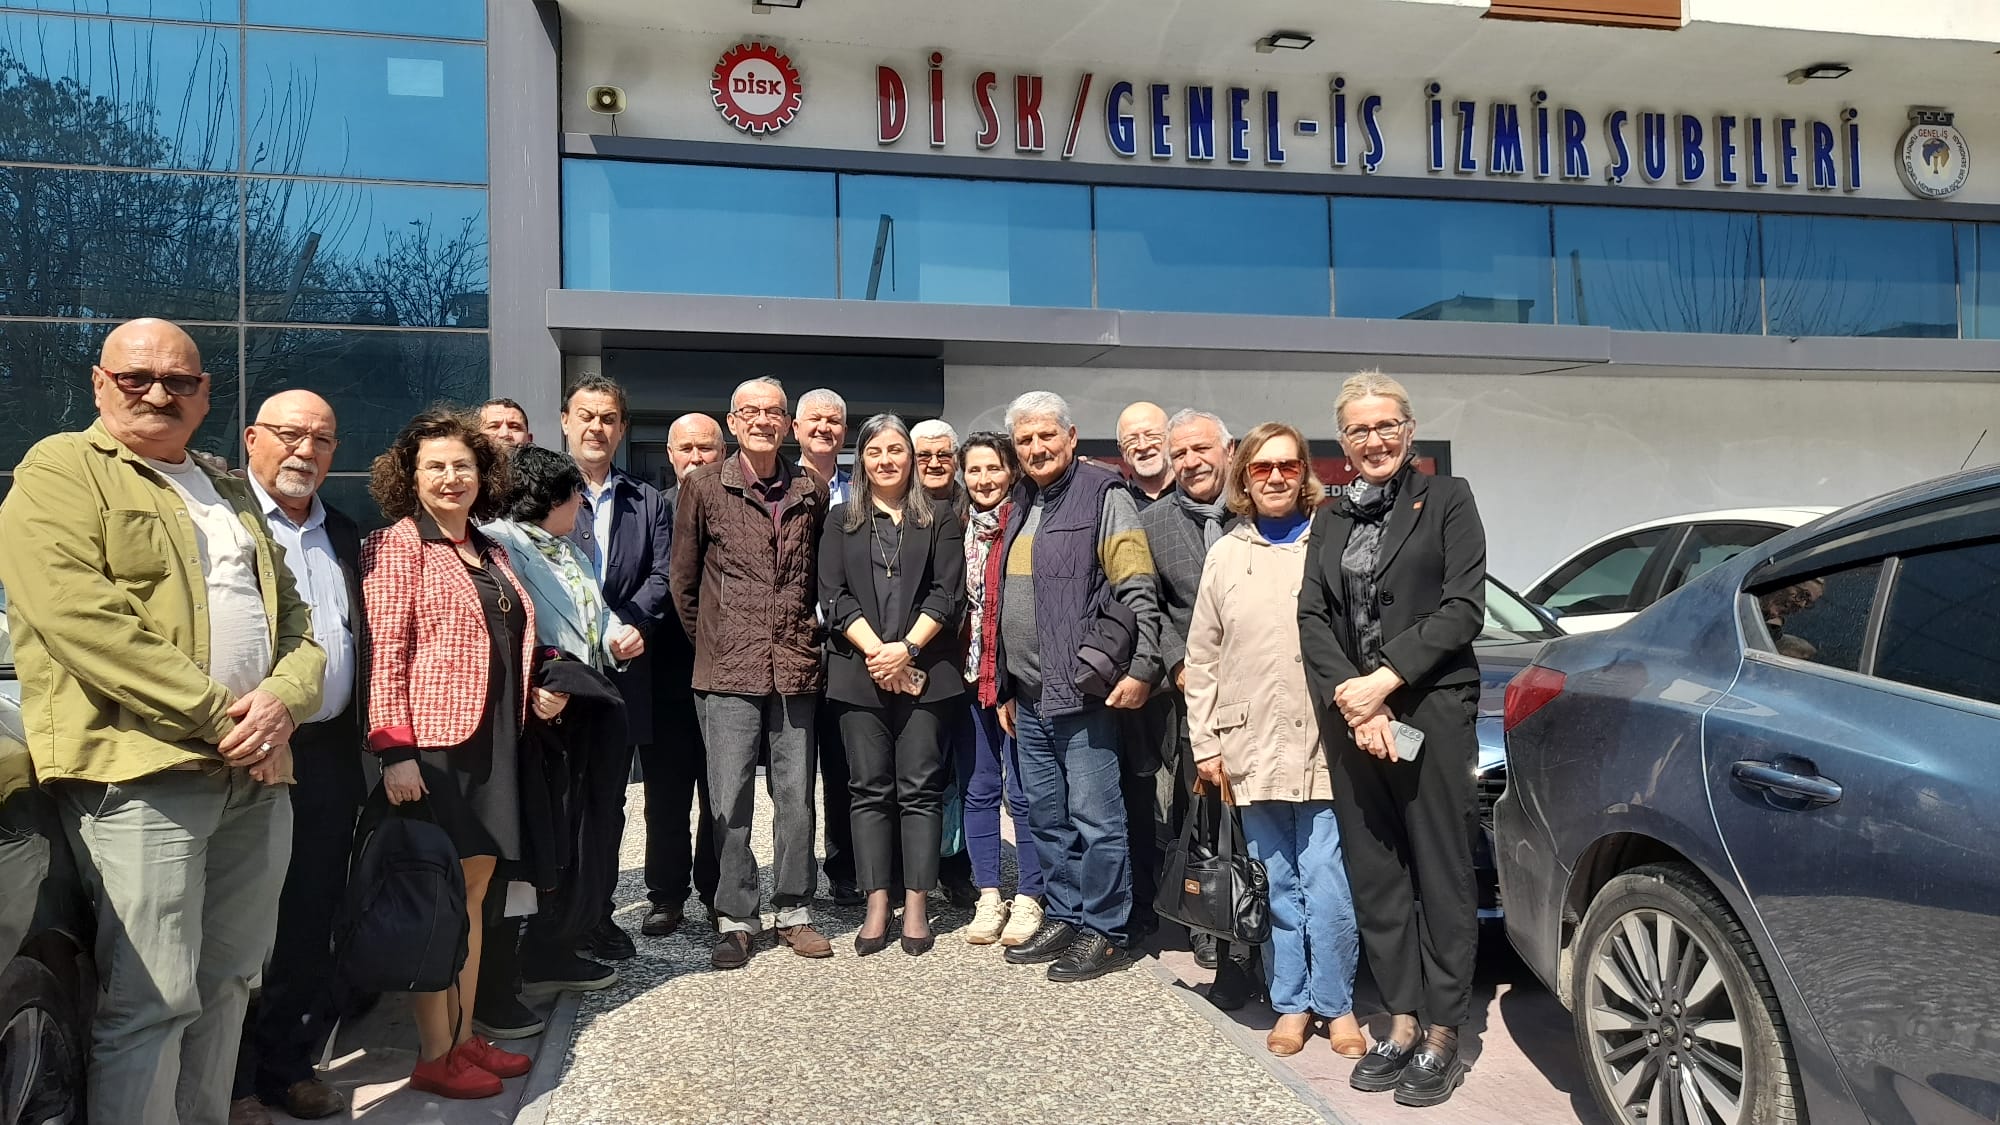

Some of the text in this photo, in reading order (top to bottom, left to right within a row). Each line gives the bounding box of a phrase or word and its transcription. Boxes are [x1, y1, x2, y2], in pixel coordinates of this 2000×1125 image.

[733, 72, 781, 95] DİSK
[1427, 82, 1591, 178] İZMİR
[1606, 108, 1862, 191] ŞUBELERİ
